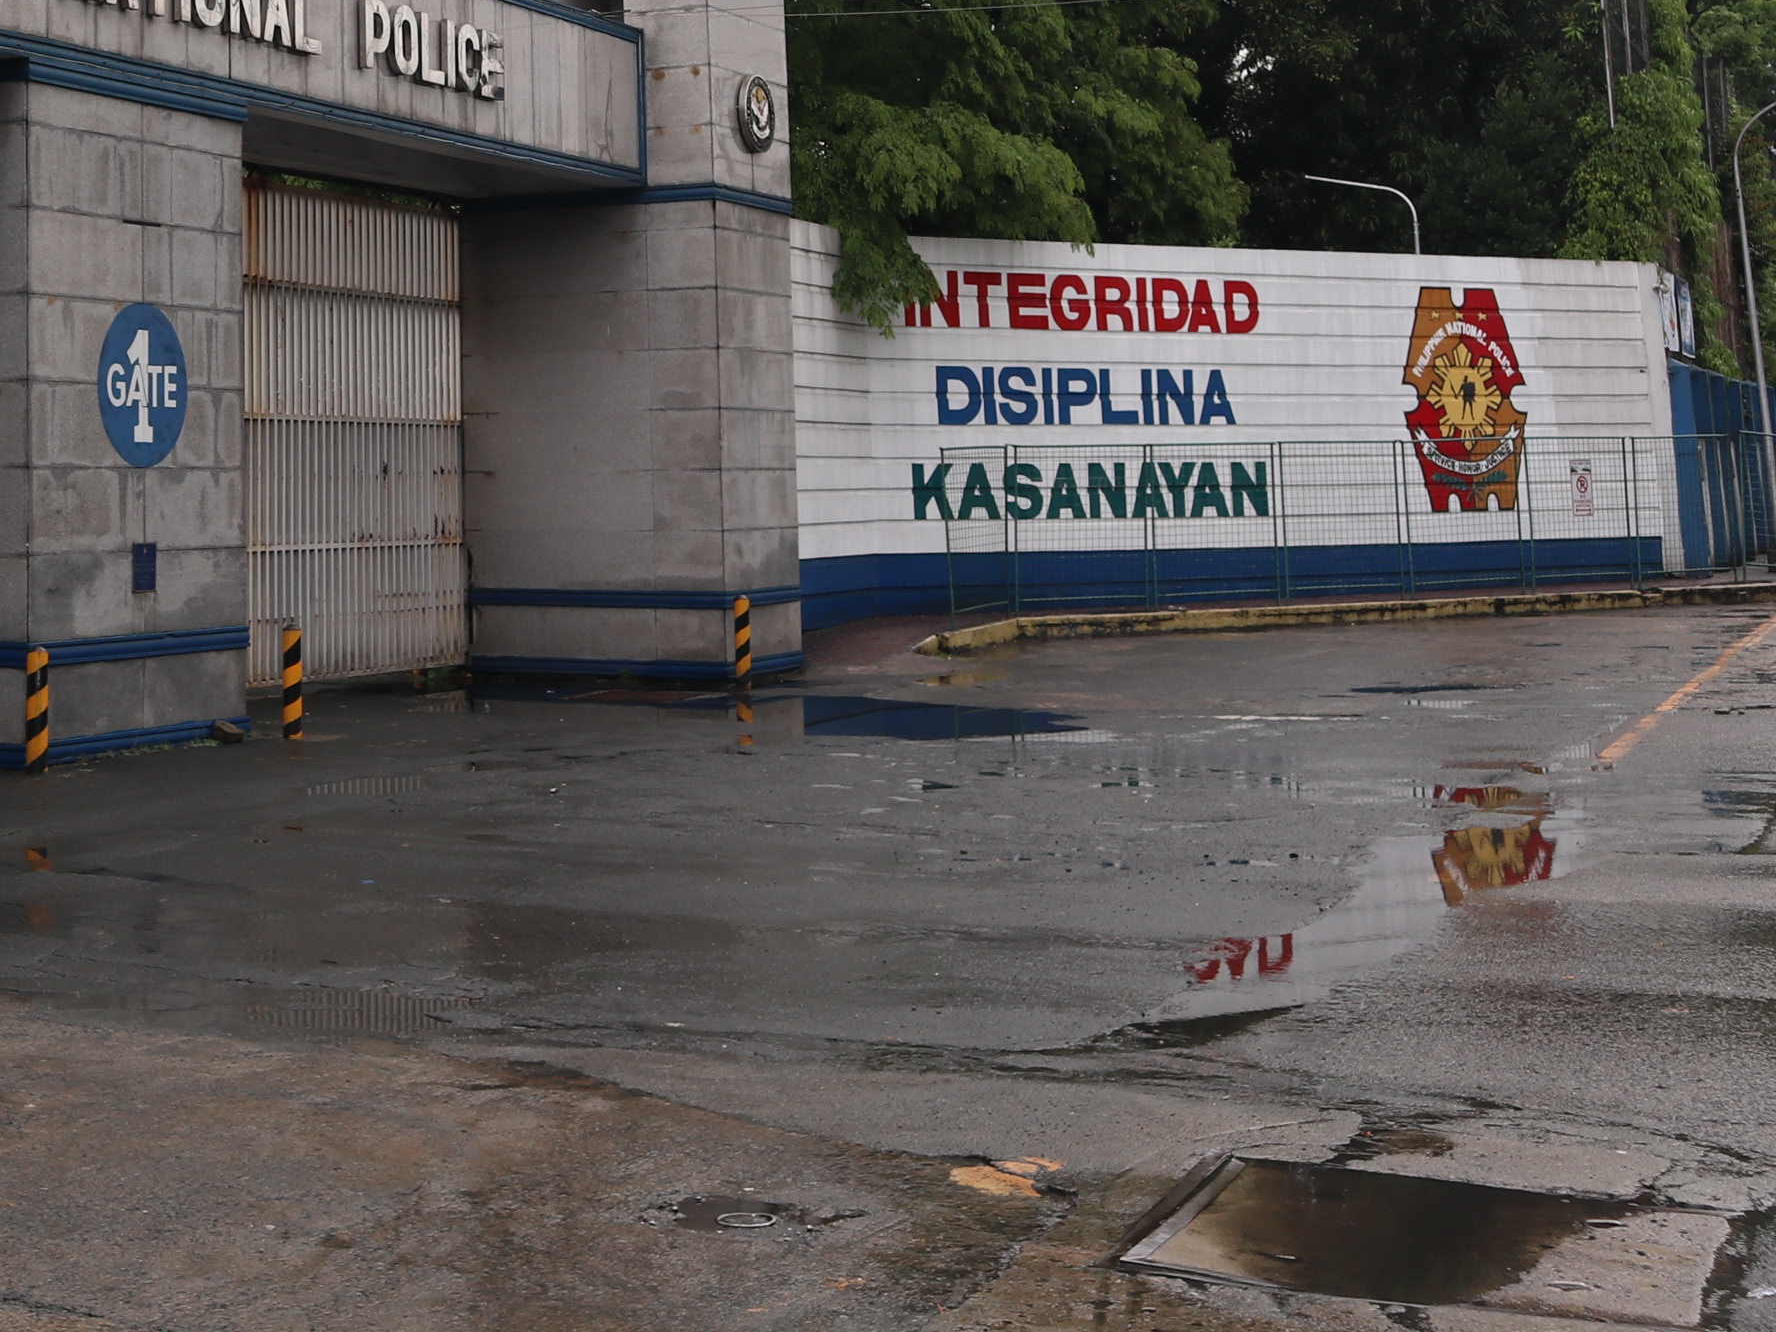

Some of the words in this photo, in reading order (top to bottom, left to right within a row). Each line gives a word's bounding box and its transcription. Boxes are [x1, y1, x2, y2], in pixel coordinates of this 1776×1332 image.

[1445, 321, 1488, 346] NATIONAL
[1487, 340, 1516, 377] POLICE
[106, 362, 178, 408] GATE
[126, 329, 154, 443] 1
[935, 365, 1237, 426] DISIPLINA
[911, 461, 1270, 521] KASANAYAN
